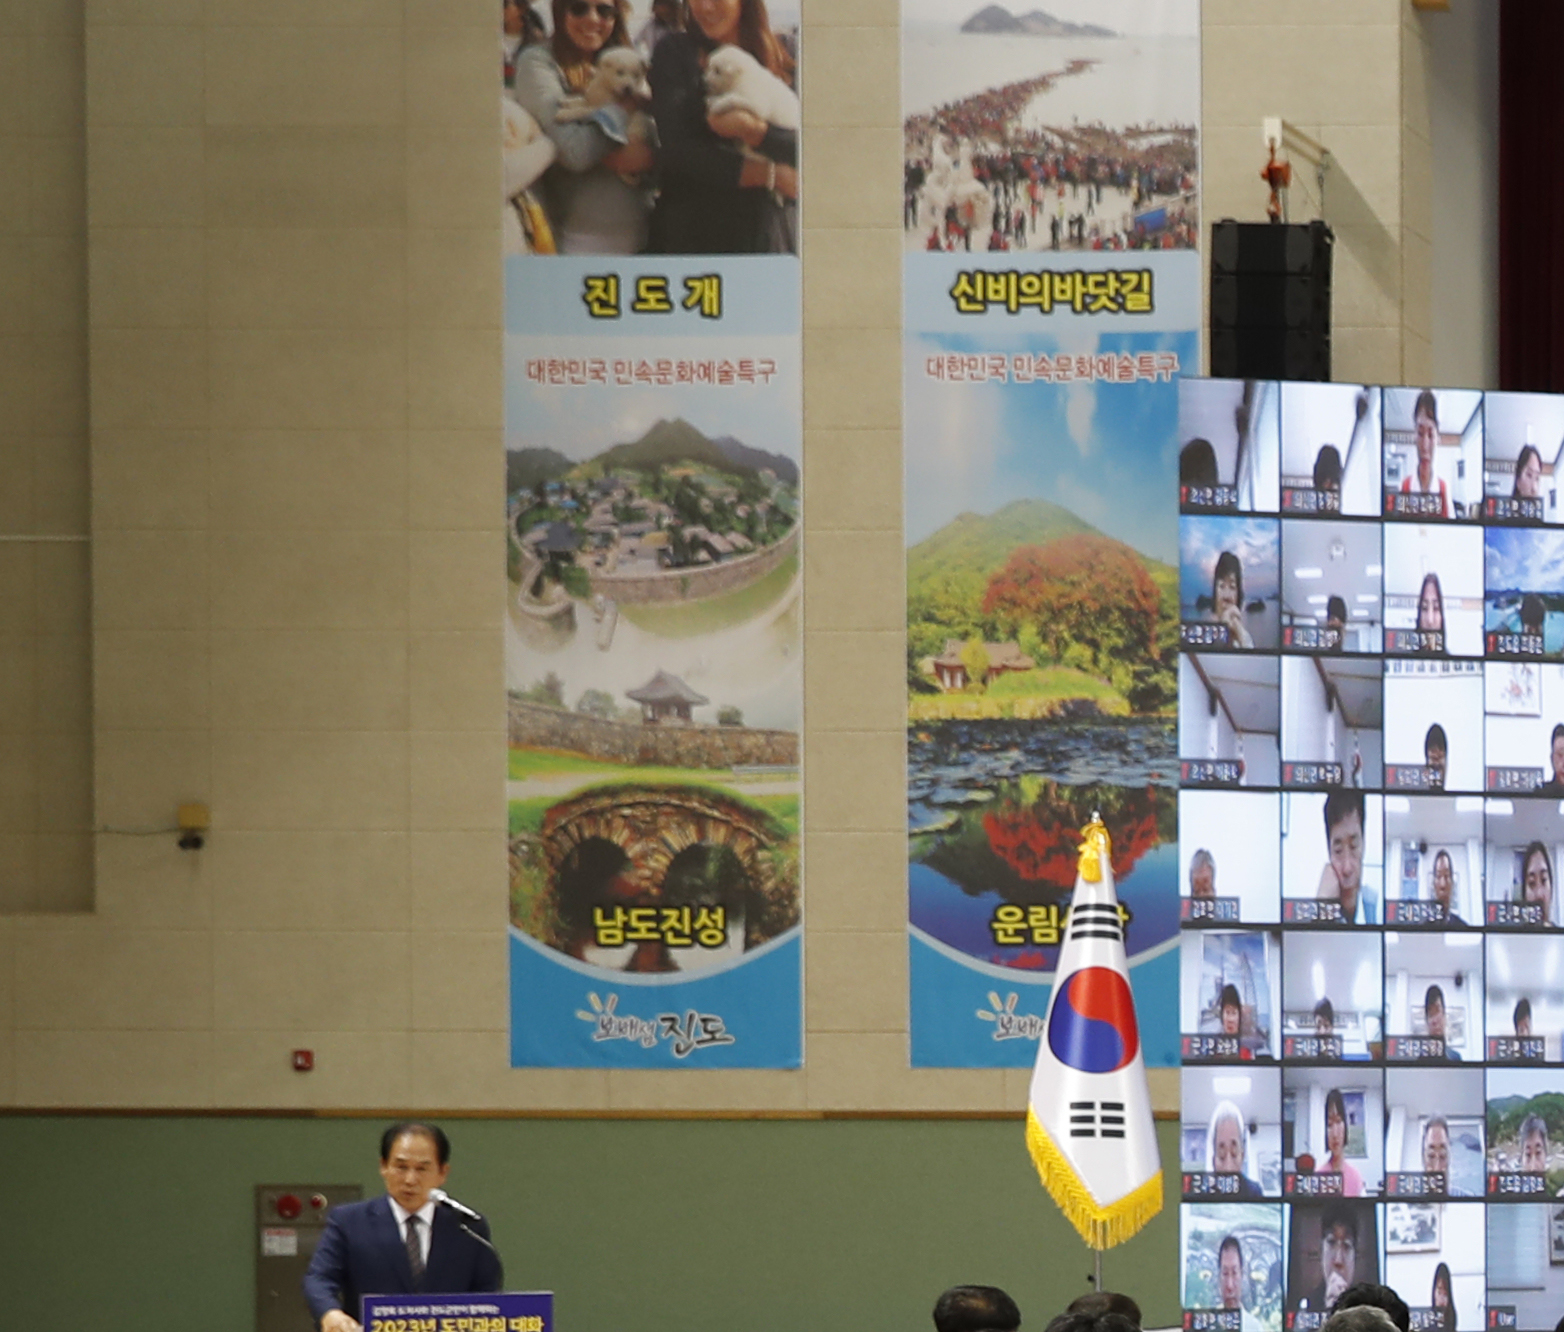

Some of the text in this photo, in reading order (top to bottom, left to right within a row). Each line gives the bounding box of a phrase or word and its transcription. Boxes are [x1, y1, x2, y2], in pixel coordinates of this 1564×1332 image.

[951, 269, 1155, 315] 신비의바닷길
[526, 356, 779, 387] 대한민국 민속문화예술특구
[926, 354, 1181, 384] 대한민국 민속문화예술특구
[592, 905, 727, 947] 남도진성
[658, 1010, 735, 1059] 진도
[994, 1014, 1045, 1041] 보배
